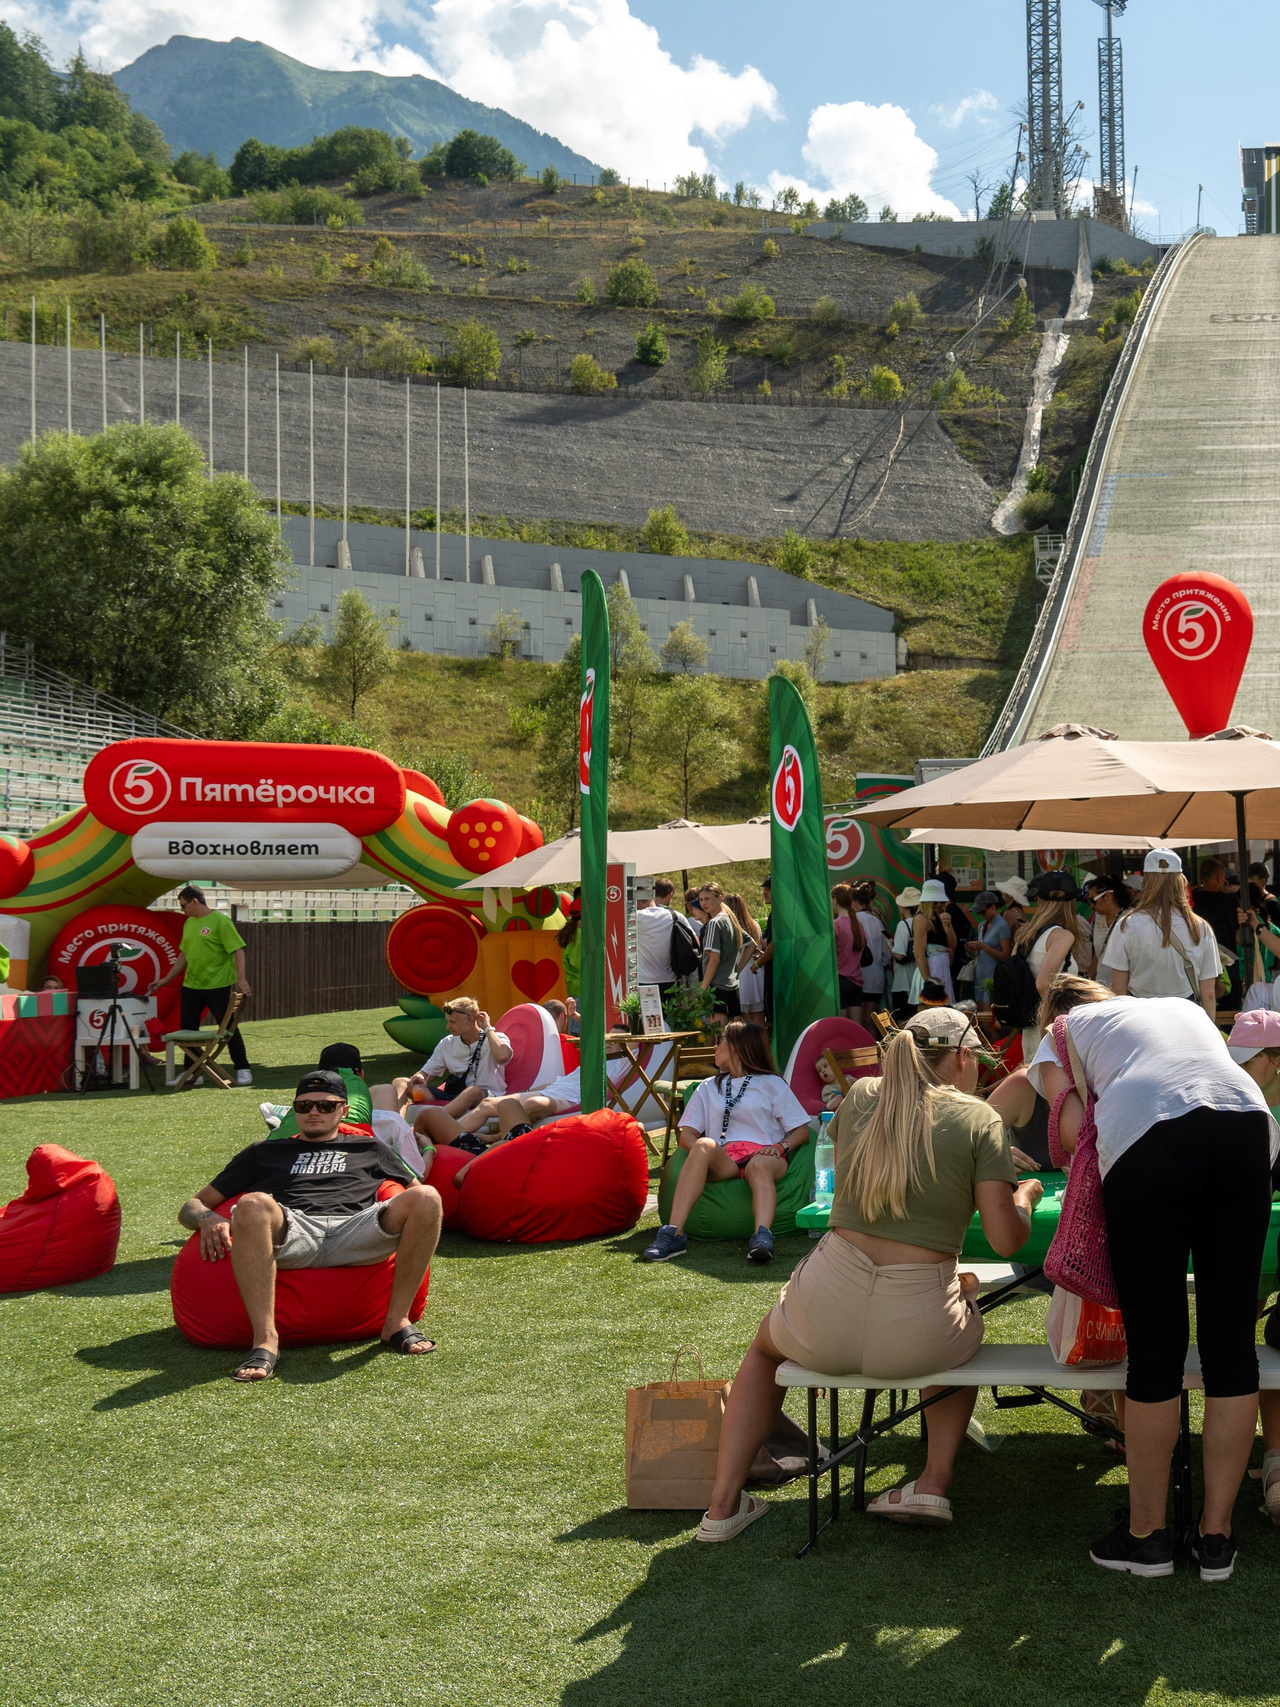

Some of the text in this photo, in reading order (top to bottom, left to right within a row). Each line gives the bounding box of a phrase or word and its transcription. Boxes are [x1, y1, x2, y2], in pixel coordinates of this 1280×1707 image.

[1152, 588, 1232, 631] Место притяжения
[1177, 603, 1207, 650] 5
[123, 763, 158, 806] 5
[179, 776, 376, 808] Пятёрочка
[168, 840, 320, 856] Вдохновляет
[825, 818, 854, 860] 5
[609, 887, 619, 901] 5
[57, 923, 178, 965] Место притяжения
[93, 1009, 106, 1027] 5
[295, 1151, 349, 1164] SIDE
[1086, 1320, 1093, 1339] С
